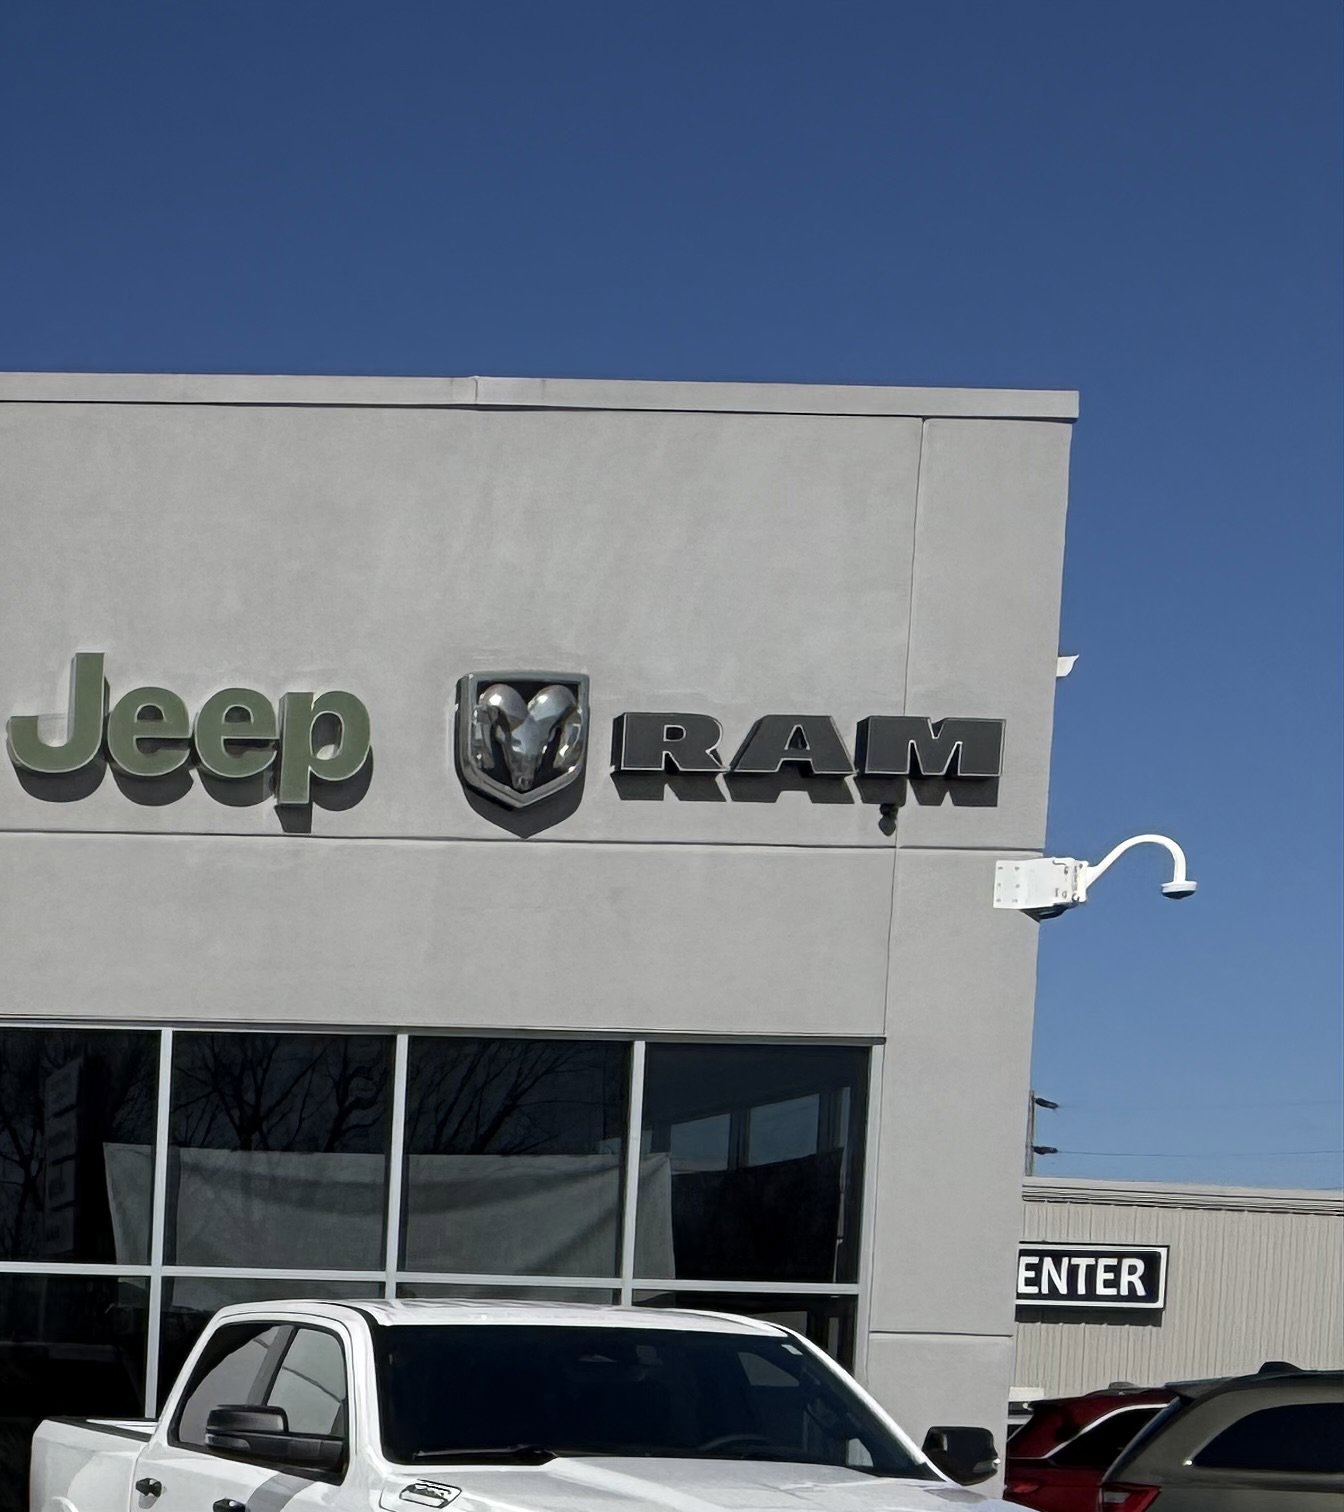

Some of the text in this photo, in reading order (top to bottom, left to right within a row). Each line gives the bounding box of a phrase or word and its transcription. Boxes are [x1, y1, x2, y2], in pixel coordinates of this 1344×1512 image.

[9, 652, 372, 804] Jeep
[616, 711, 1007, 778] RAM
[1016, 1255, 1148, 1297] ENTER
